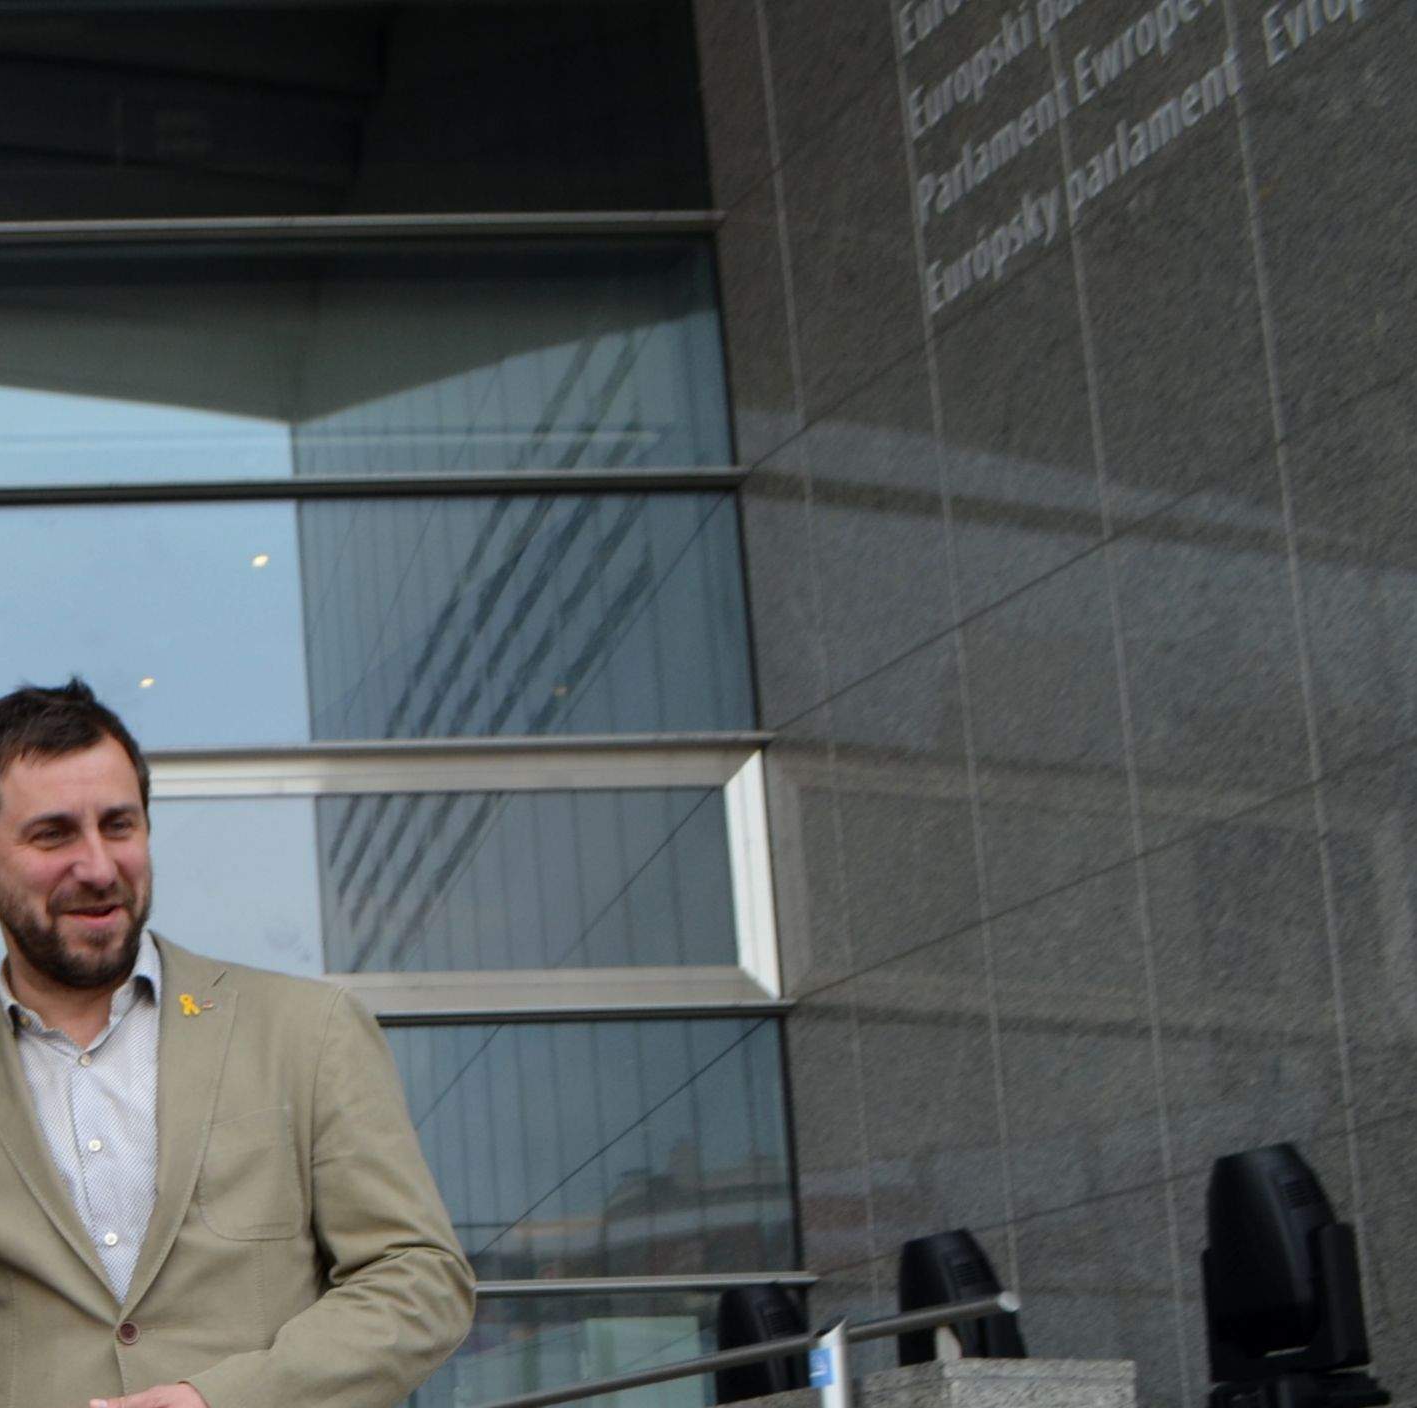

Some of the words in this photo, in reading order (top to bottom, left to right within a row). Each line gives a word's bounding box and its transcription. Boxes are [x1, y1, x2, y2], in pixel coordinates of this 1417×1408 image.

[918, 77, 1069, 227] Parlament
[926, 186, 1059, 315] Európsky
[1067, 49, 1242, 228] parlament
